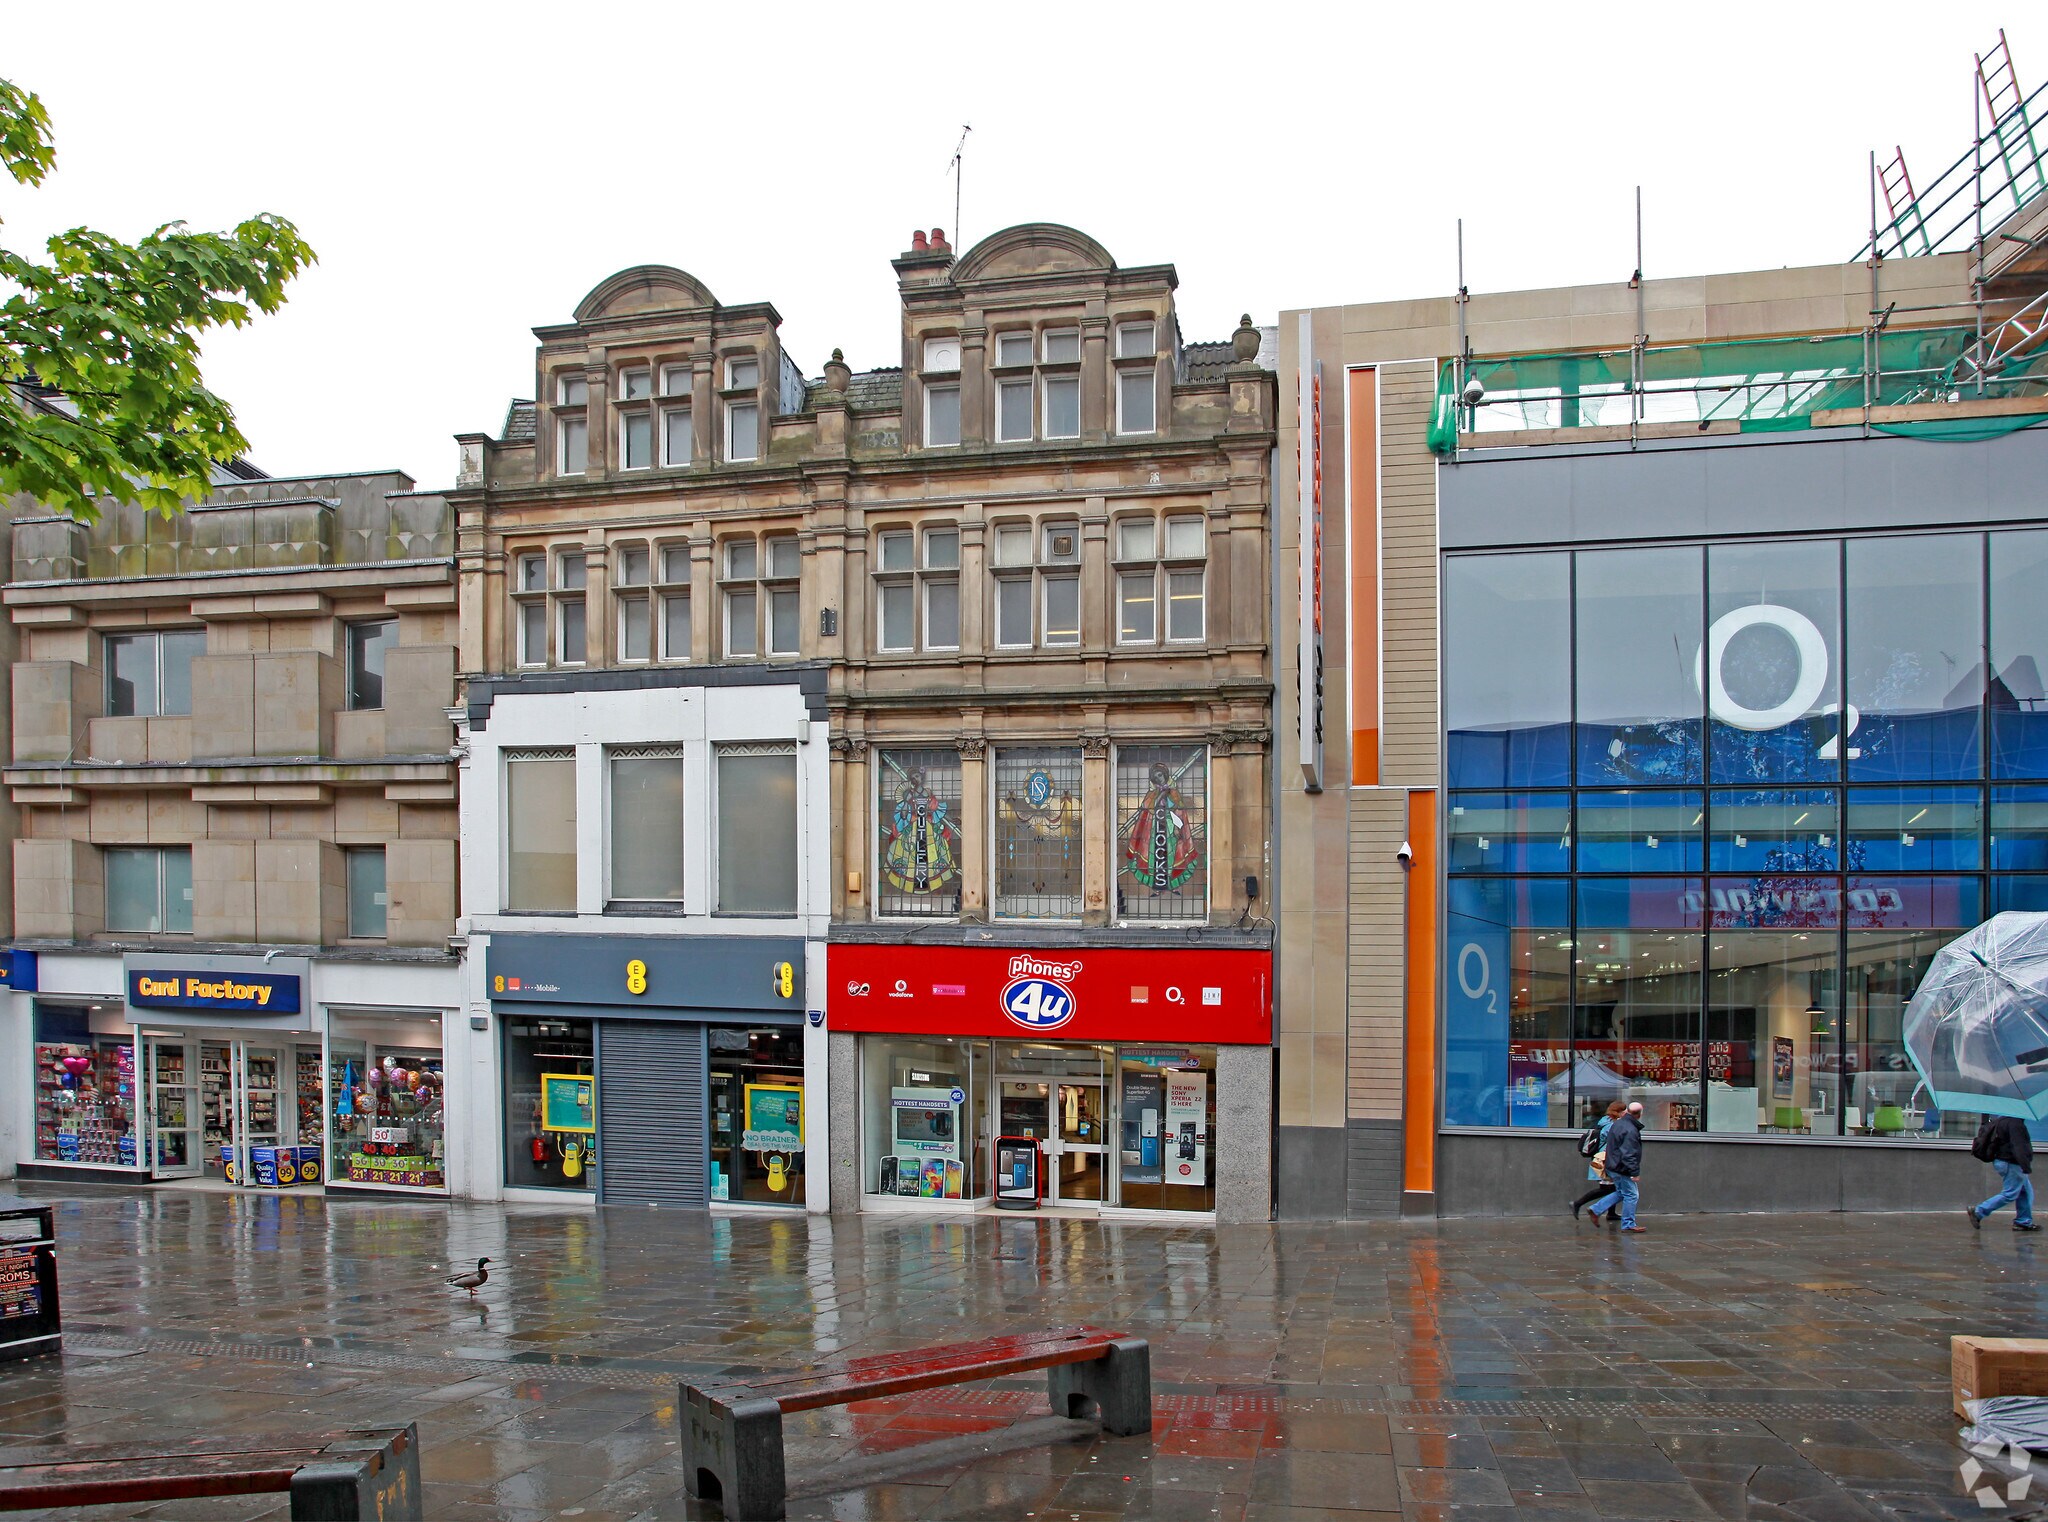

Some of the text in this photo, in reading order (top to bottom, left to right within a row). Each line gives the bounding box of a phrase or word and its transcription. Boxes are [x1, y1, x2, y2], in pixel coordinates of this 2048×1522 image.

[1694, 604, 1861, 760] O2
[916, 804, 927, 888] CUTLERY
[1155, 808, 1167, 886] CLOCKS
[1012, 955, 1072, 979] phones
[1458, 942, 1497, 1014] O2
[139, 977, 273, 1005] Card Factory
[1165, 986, 1186, 1005] O2
[1011, 983, 1067, 1022] 4u
[374, 1131, 388, 1140] 50
[760, 1135, 797, 1143] BRAINER
[60, 1149, 76, 1157] Quality
[363, 1144, 377, 1154] 40
[382, 1145, 397, 1155] 40
[120, 1152, 136, 1161] Quality
[374, 1157, 386, 1166] 30
[256, 1163, 274, 1173] Quality
[393, 1159, 405, 1168] 30
[353, 1169, 364, 1179] 21
[373, 1171, 384, 1180] 21
[390, 1172, 402, 1182] 21
[409, 1173, 420, 1183] 21
[9, 1262, 30, 1271] NIGHT
